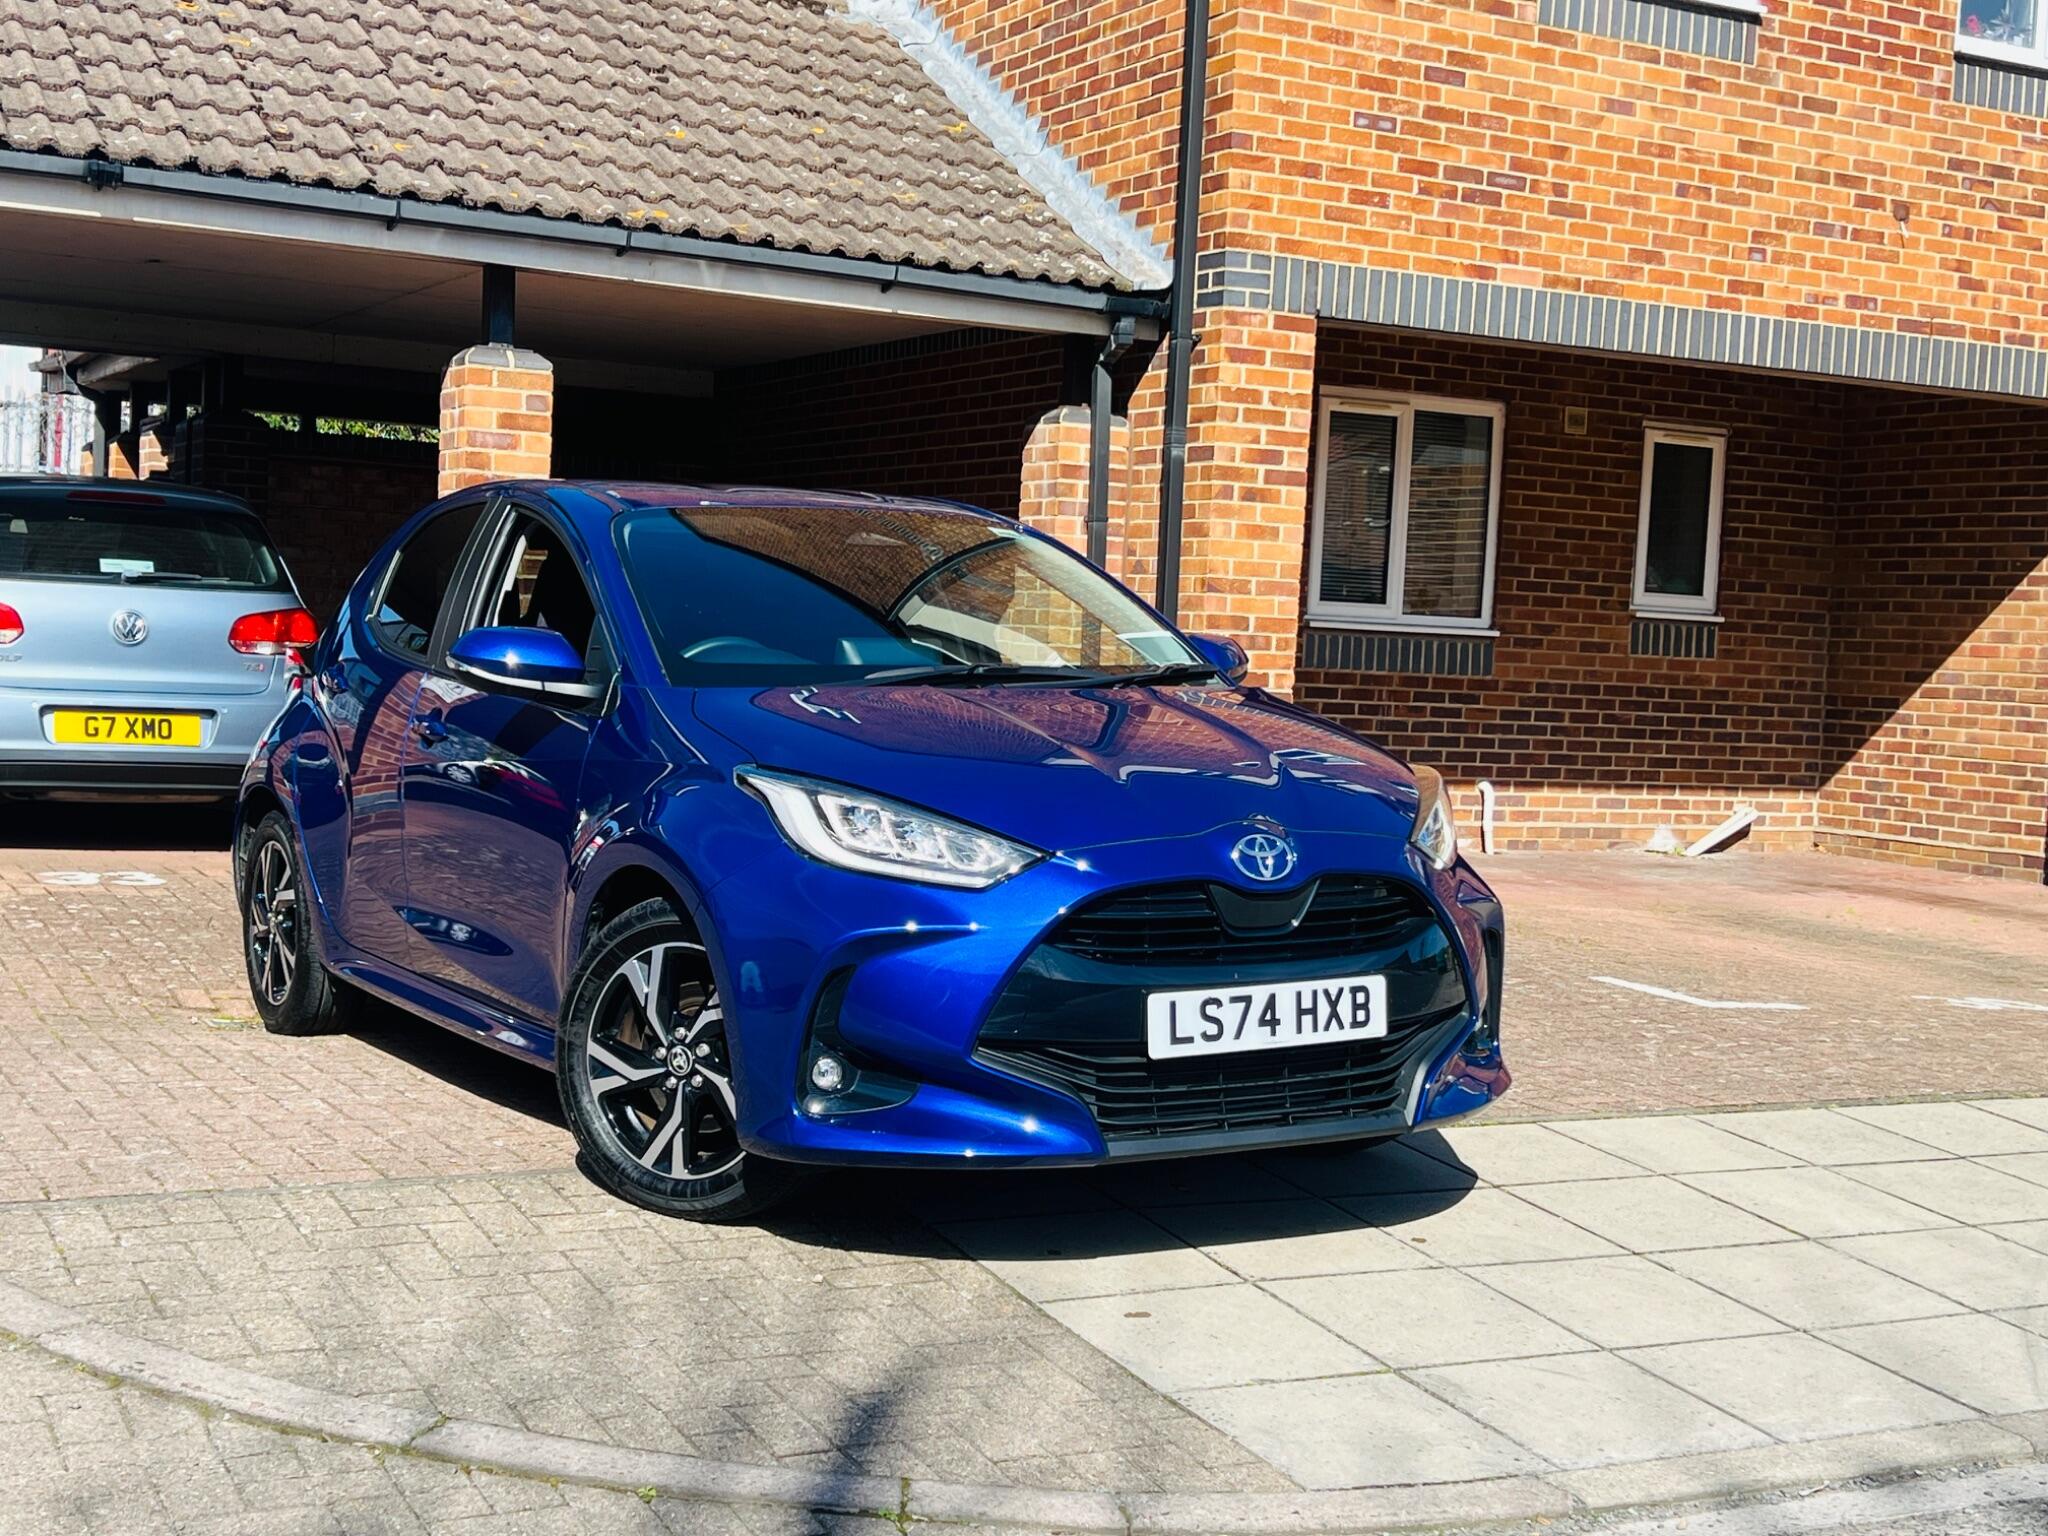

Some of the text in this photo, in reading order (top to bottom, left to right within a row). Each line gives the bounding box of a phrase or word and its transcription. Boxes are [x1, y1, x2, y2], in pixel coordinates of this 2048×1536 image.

[84, 715, 173, 740] G7 XMO
[1168, 984, 1371, 1046] LS74 HXB
